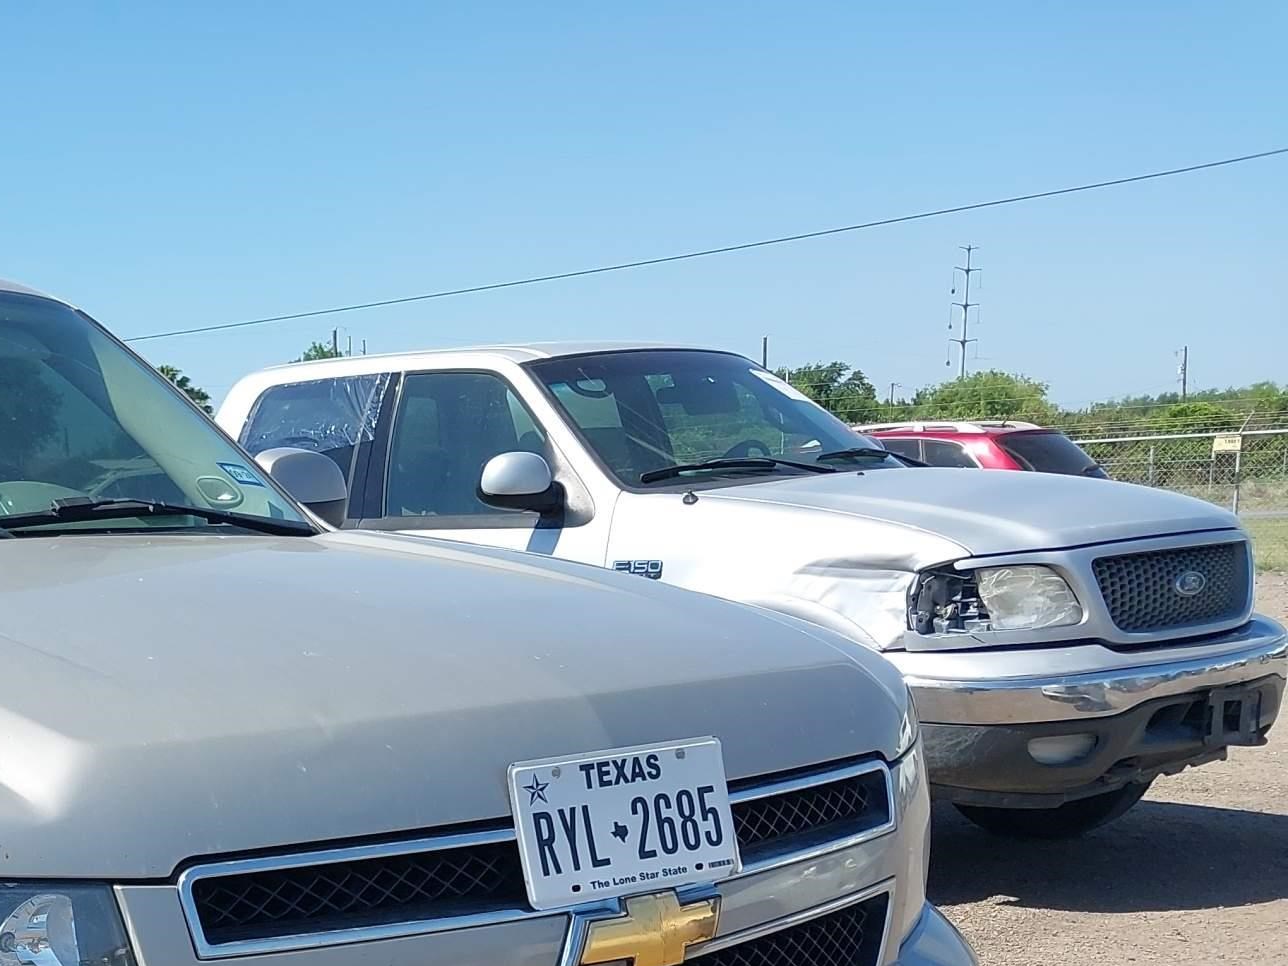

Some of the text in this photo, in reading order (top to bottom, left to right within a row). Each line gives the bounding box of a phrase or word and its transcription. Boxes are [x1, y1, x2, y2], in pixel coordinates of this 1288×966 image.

[579, 753, 662, 790] TEXAS
[532, 785, 723, 877] RYL 2685
[590, 865, 688, 891] The Lone Star State
